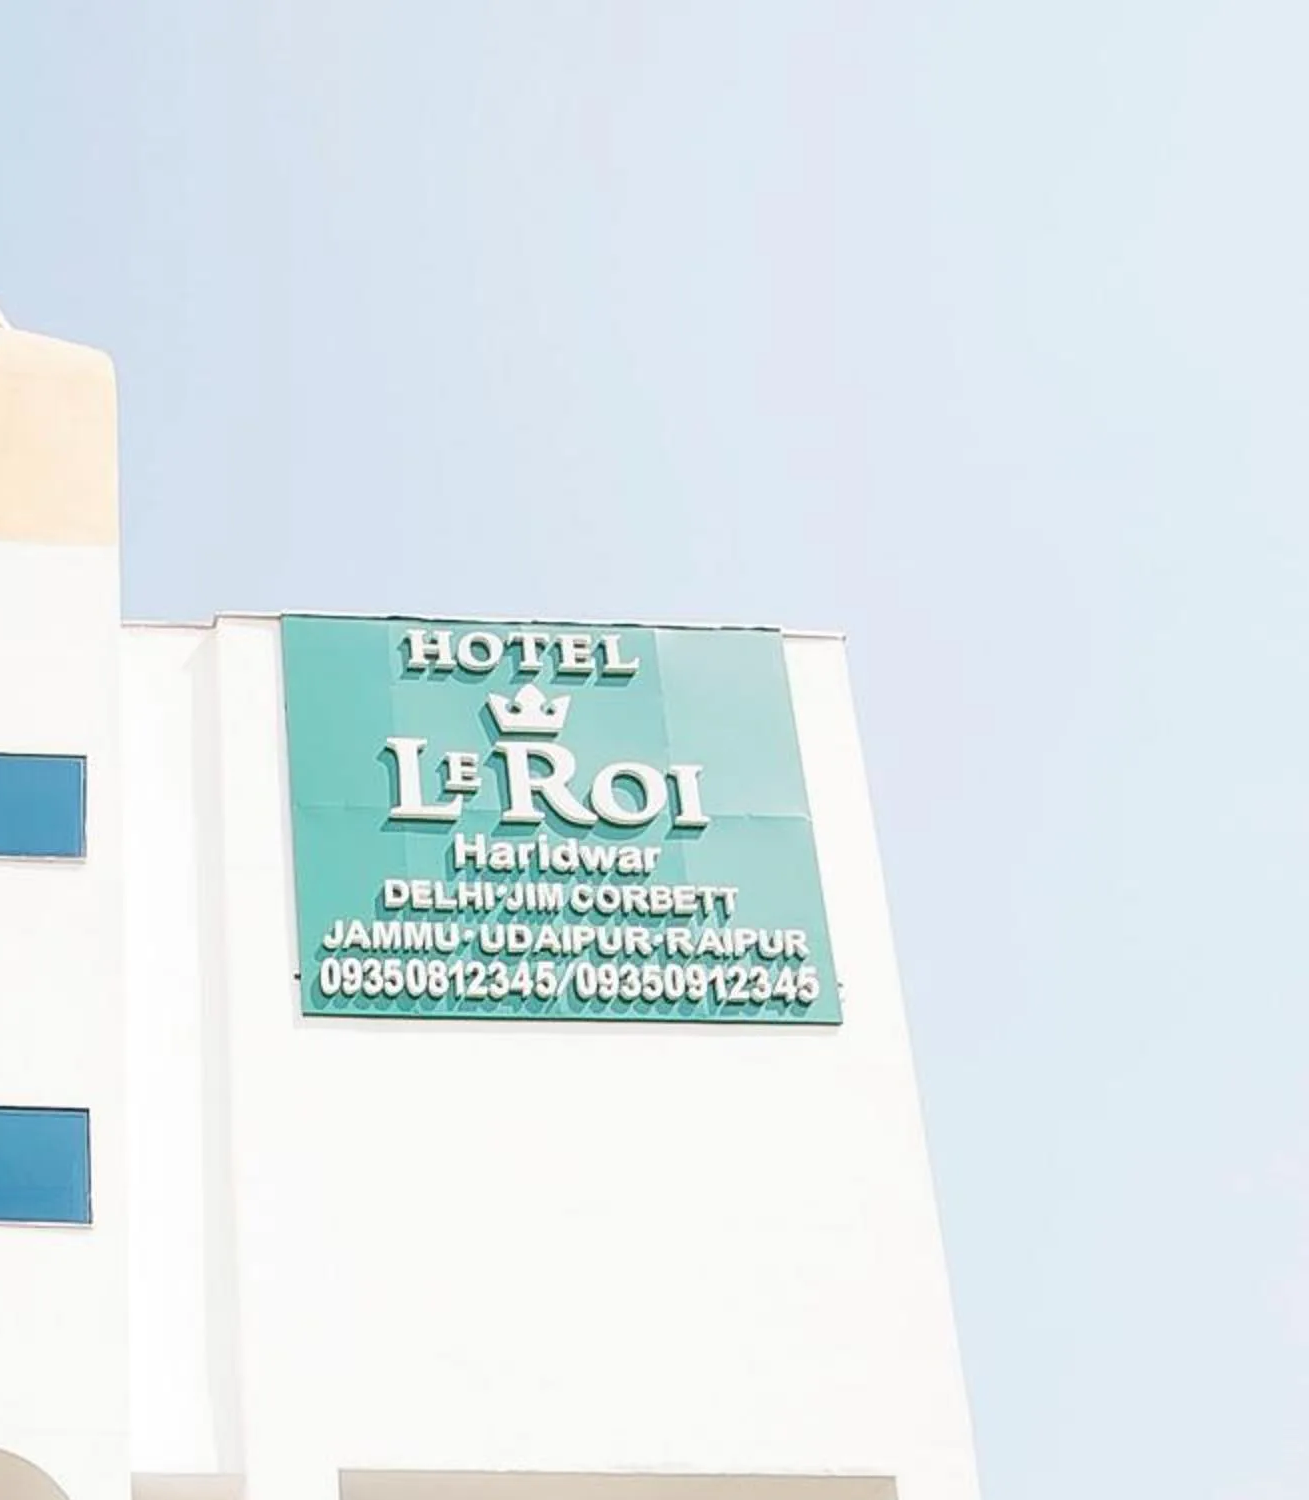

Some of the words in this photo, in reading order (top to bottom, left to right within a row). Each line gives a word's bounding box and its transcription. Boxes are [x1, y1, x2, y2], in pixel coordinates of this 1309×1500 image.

[407, 629, 640, 674] HOTEL
[453, 832, 661, 874] Haridwar
[570, 884, 739, 917] CORBETT
